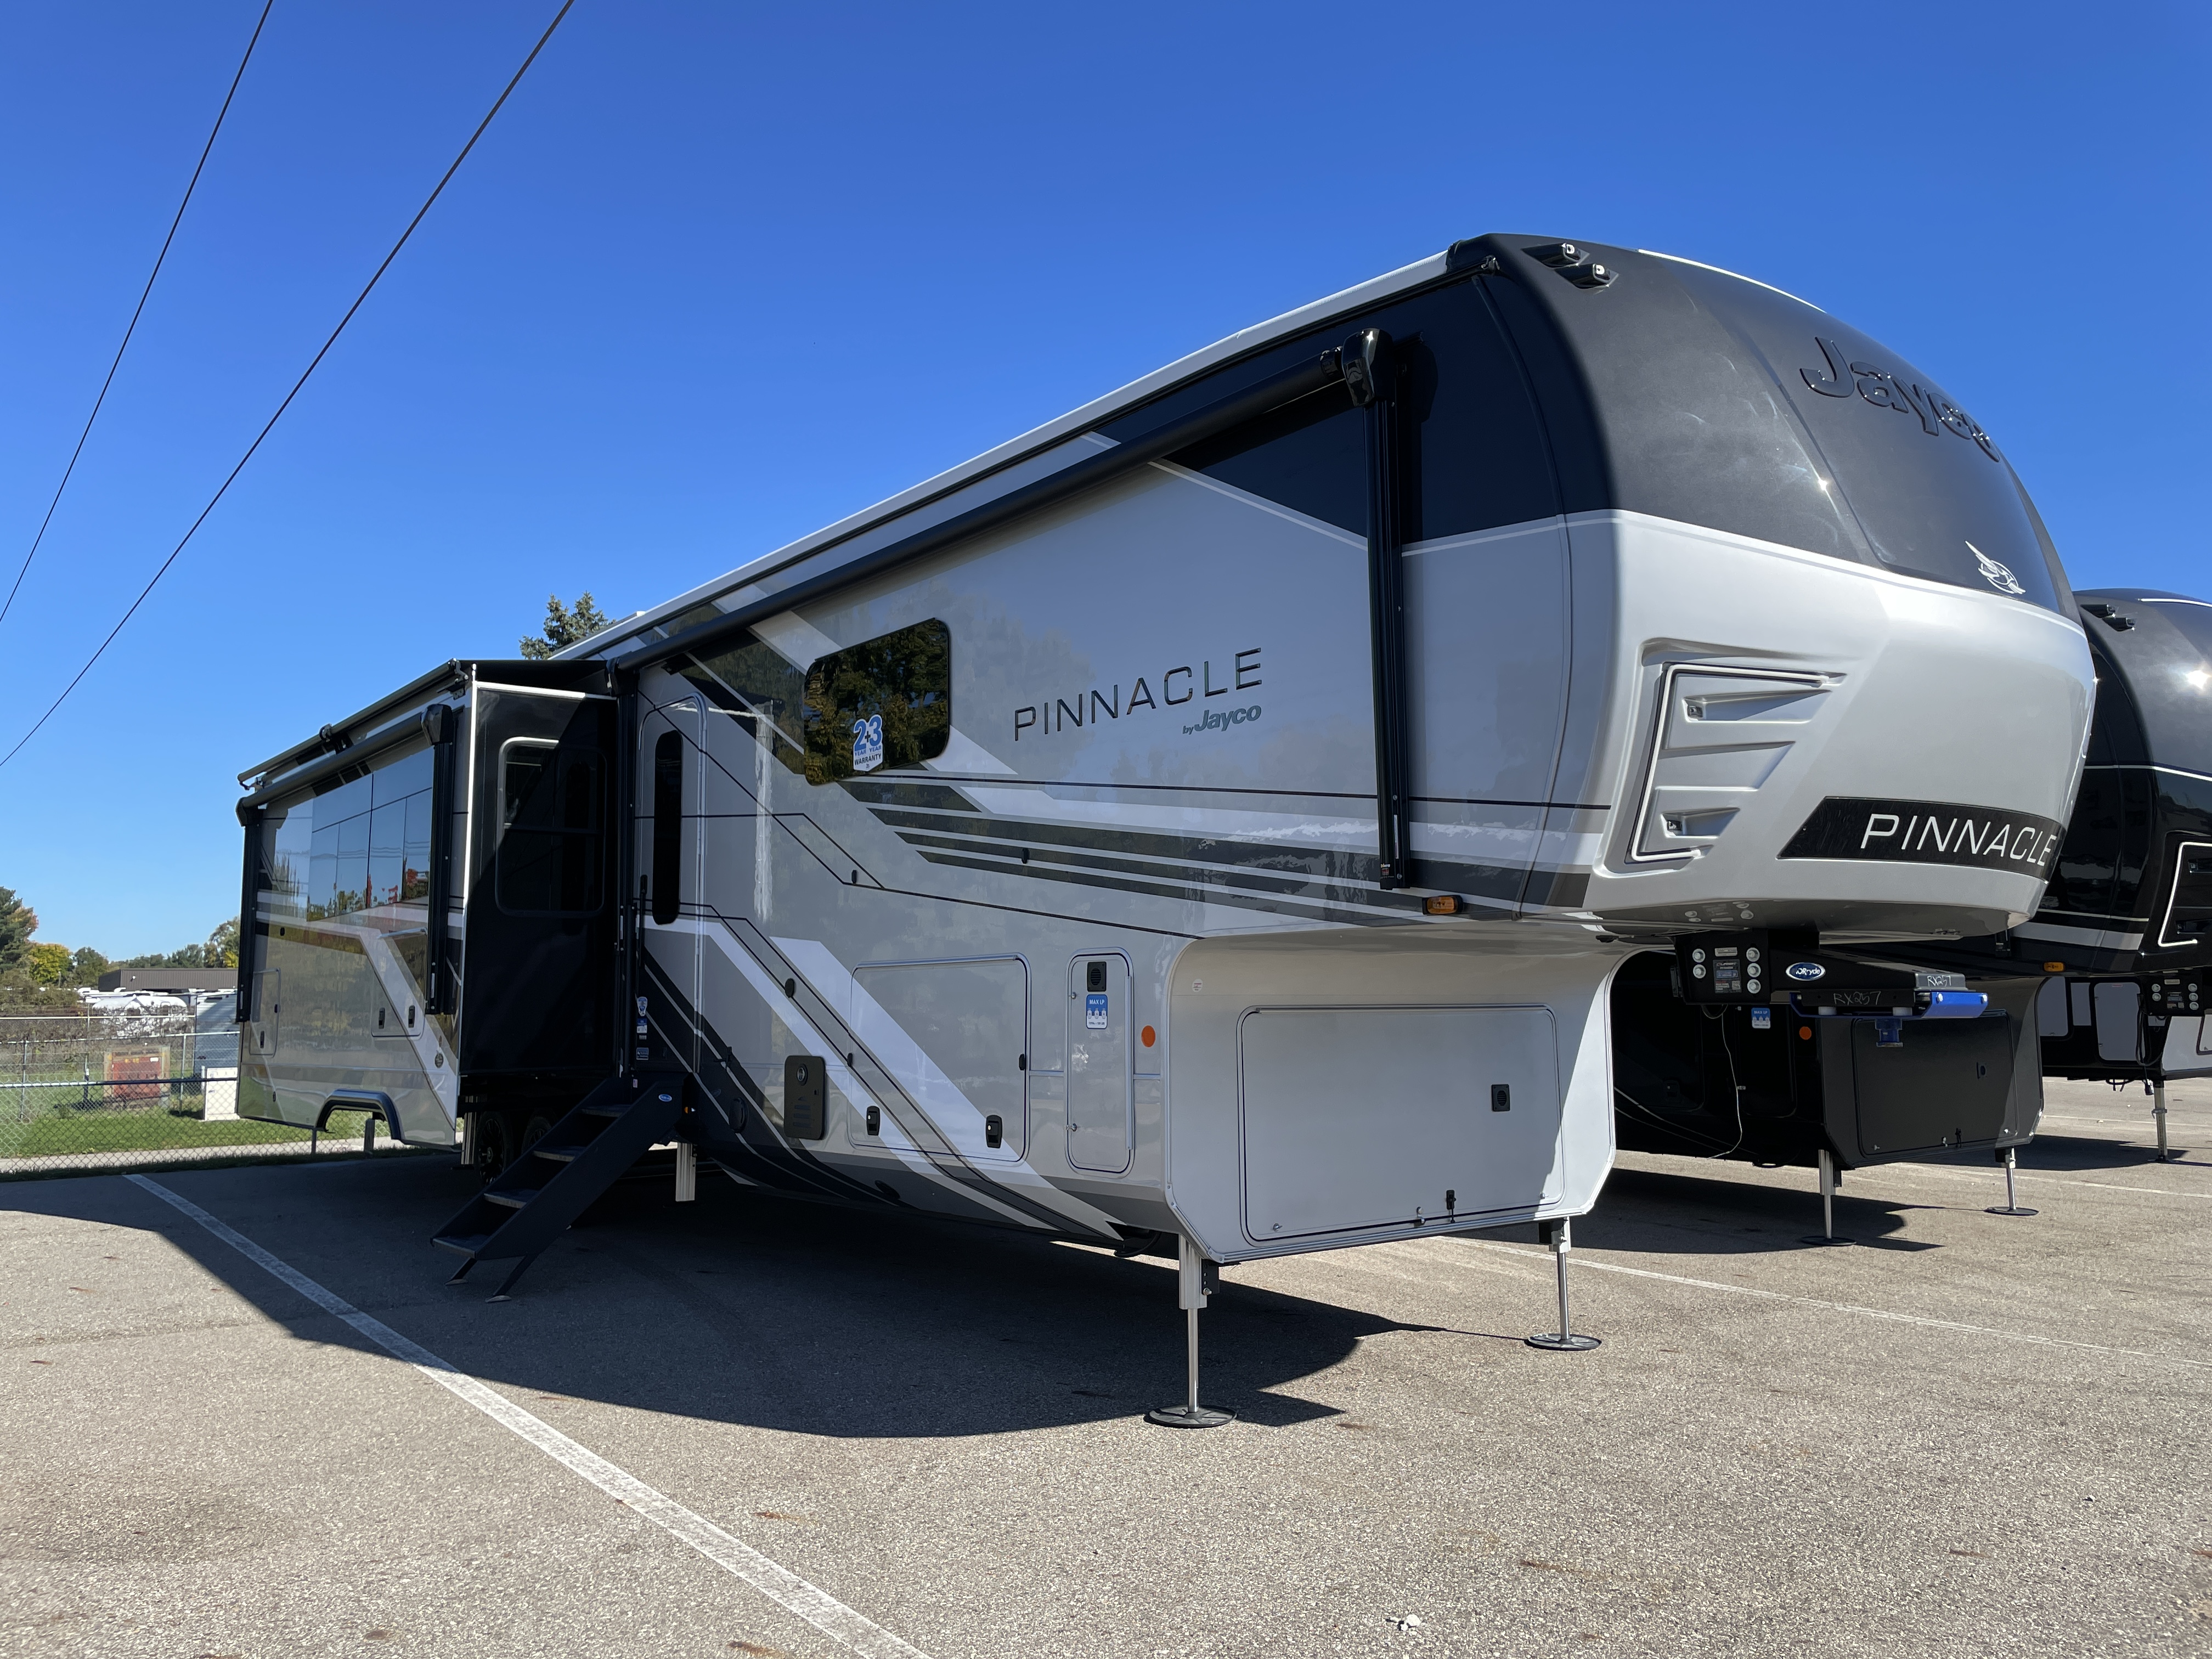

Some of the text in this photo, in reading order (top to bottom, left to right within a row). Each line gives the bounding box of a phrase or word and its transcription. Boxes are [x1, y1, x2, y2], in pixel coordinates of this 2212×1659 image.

[1799, 336, 2000, 462] Jayco
[1014, 647, 1262, 741] PINNACLE
[1182, 705, 1262, 735] by Jayco
[854, 753, 882, 766] WARRANTY
[1860, 813, 2057, 866] PINNACLE
[1927, 975, 1951, 986] RX257
[1833, 991, 1881, 1006] RX257
